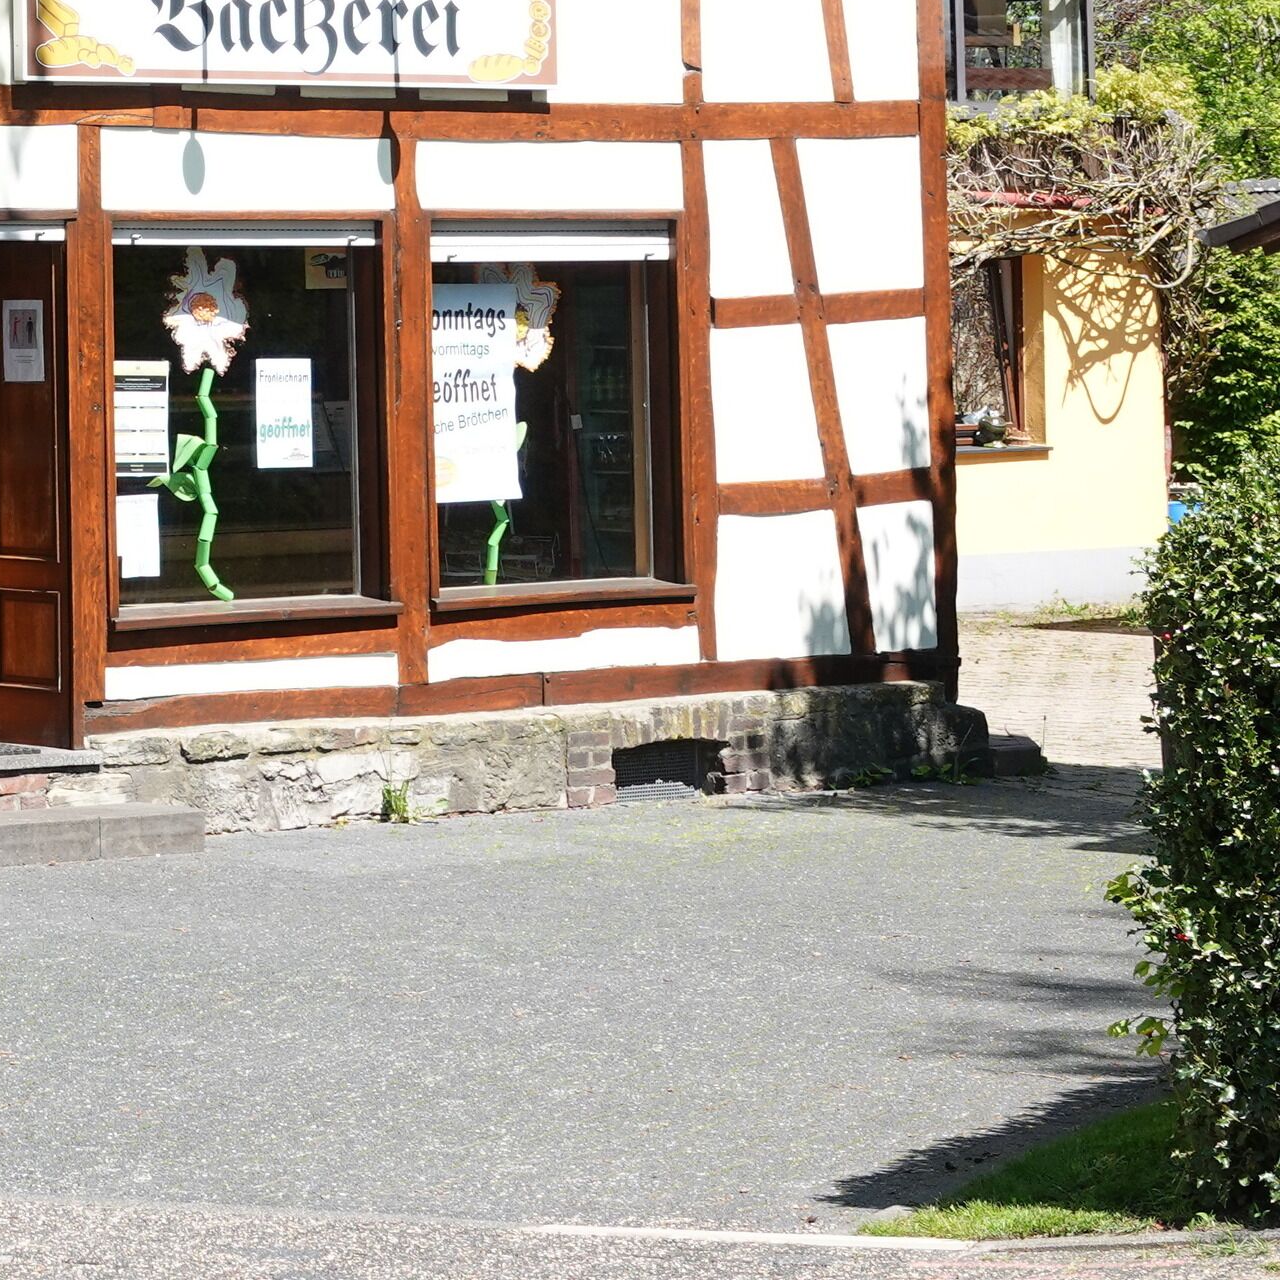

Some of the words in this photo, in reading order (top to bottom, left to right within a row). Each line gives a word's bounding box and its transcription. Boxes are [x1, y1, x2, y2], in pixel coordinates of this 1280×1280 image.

[432, 302, 506, 338] onntags
[259, 369, 309, 383] Fronleichnam
[432, 368, 497, 404] eöffnet
[259, 416, 311, 444] geöffnet
[458, 407, 509, 429] Brötchen
